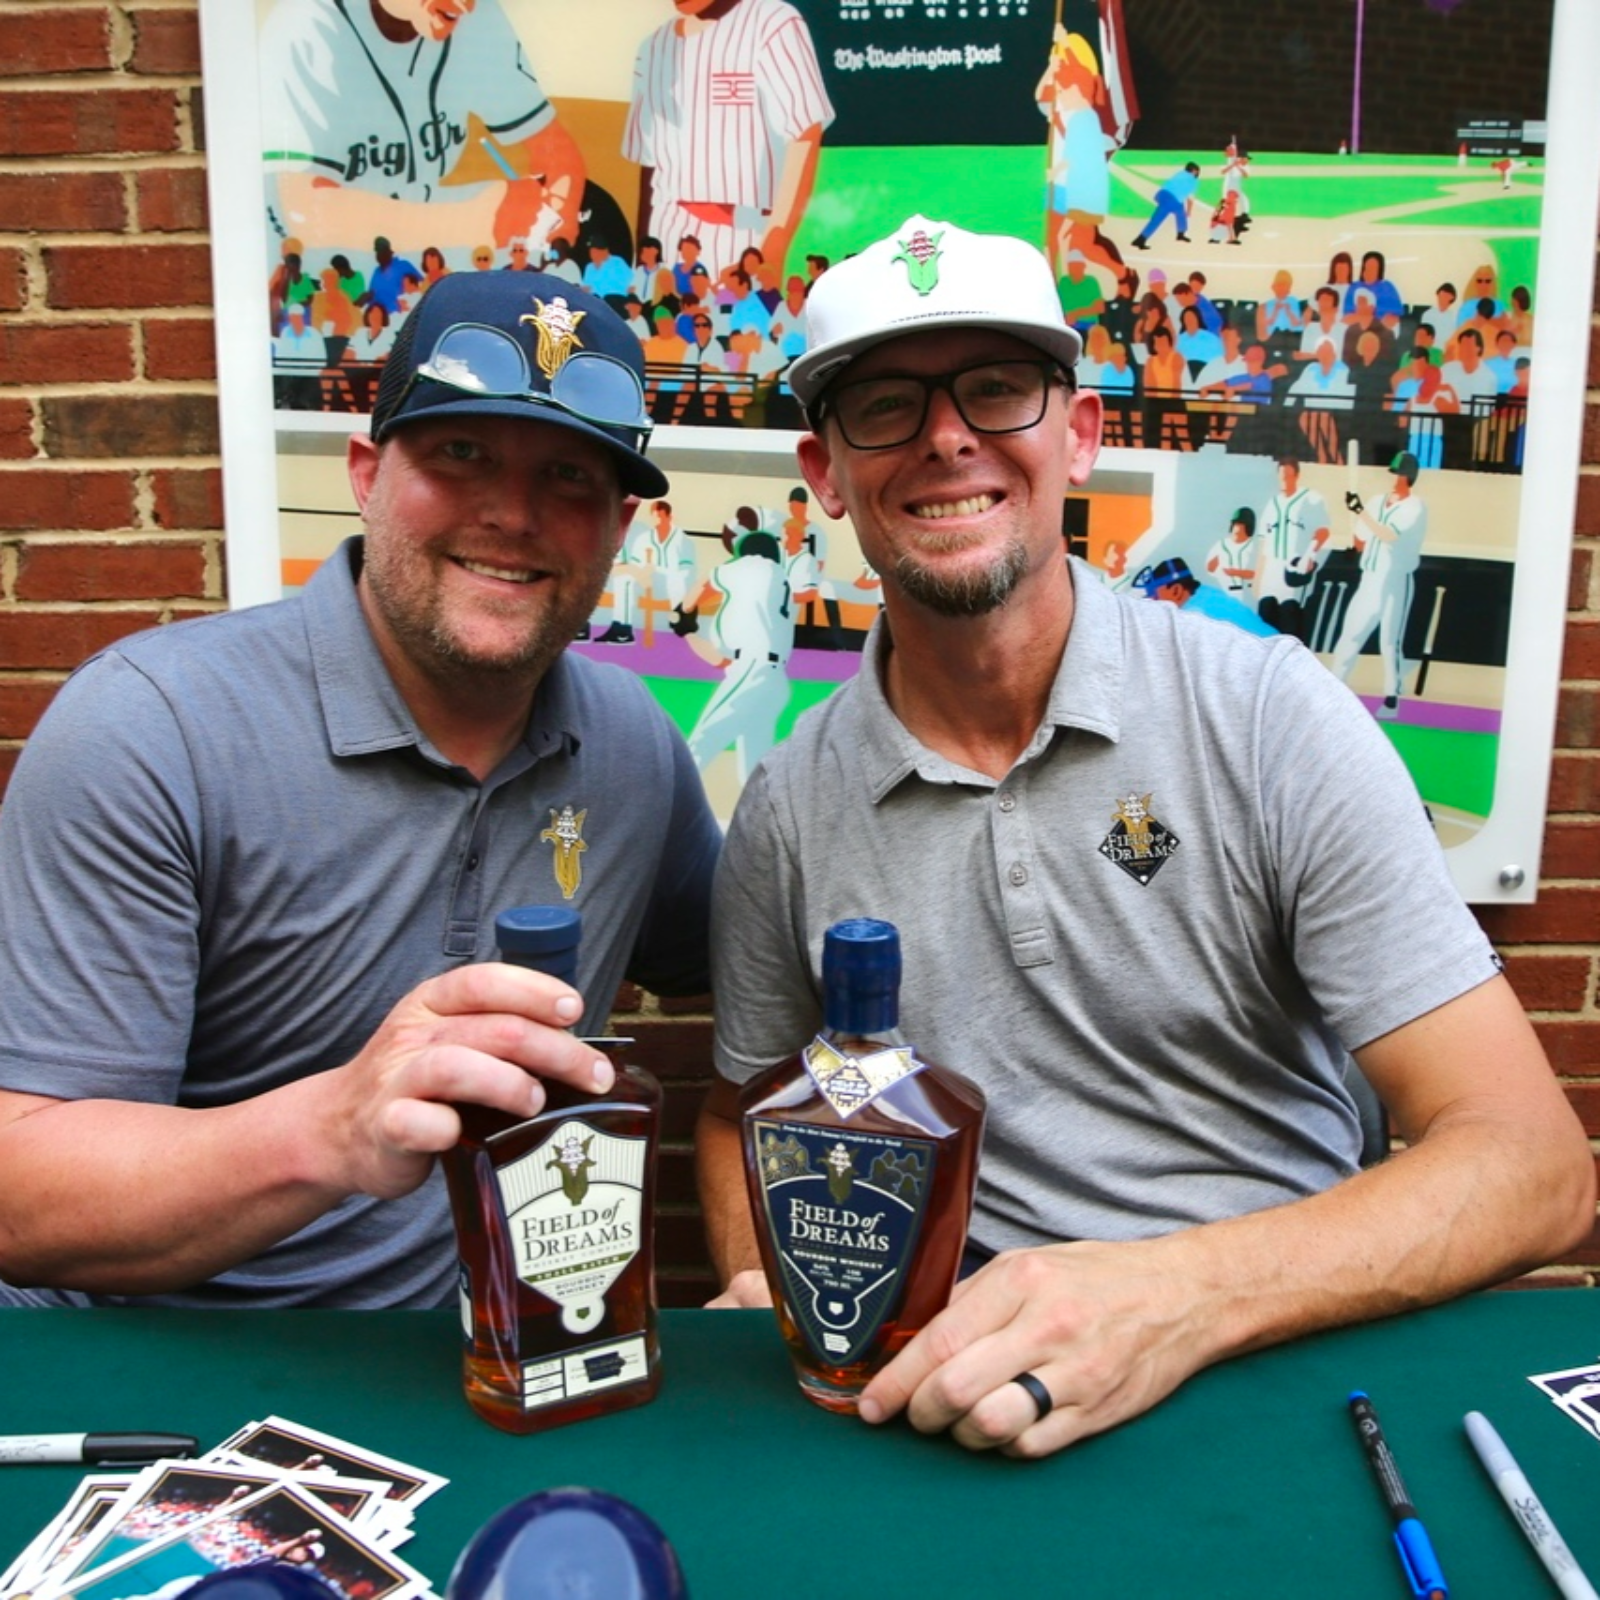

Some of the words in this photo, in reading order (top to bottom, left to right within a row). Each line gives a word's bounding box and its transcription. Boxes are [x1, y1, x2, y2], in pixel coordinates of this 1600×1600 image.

[964, 43, 1002, 69] Post
[344, 135, 406, 182] Big
[523, 1208, 599, 1239] FIELD
[601, 1198, 625, 1226] of
[789, 1198, 859, 1228] FIELD
[860, 1212, 886, 1234] of
[524, 1221, 633, 1262] DREAMS
[789, 1218, 890, 1252] DREAMS
[793, 1249, 837, 1263] BOURBON
[839, 1257, 883, 1270] WHISKEY
